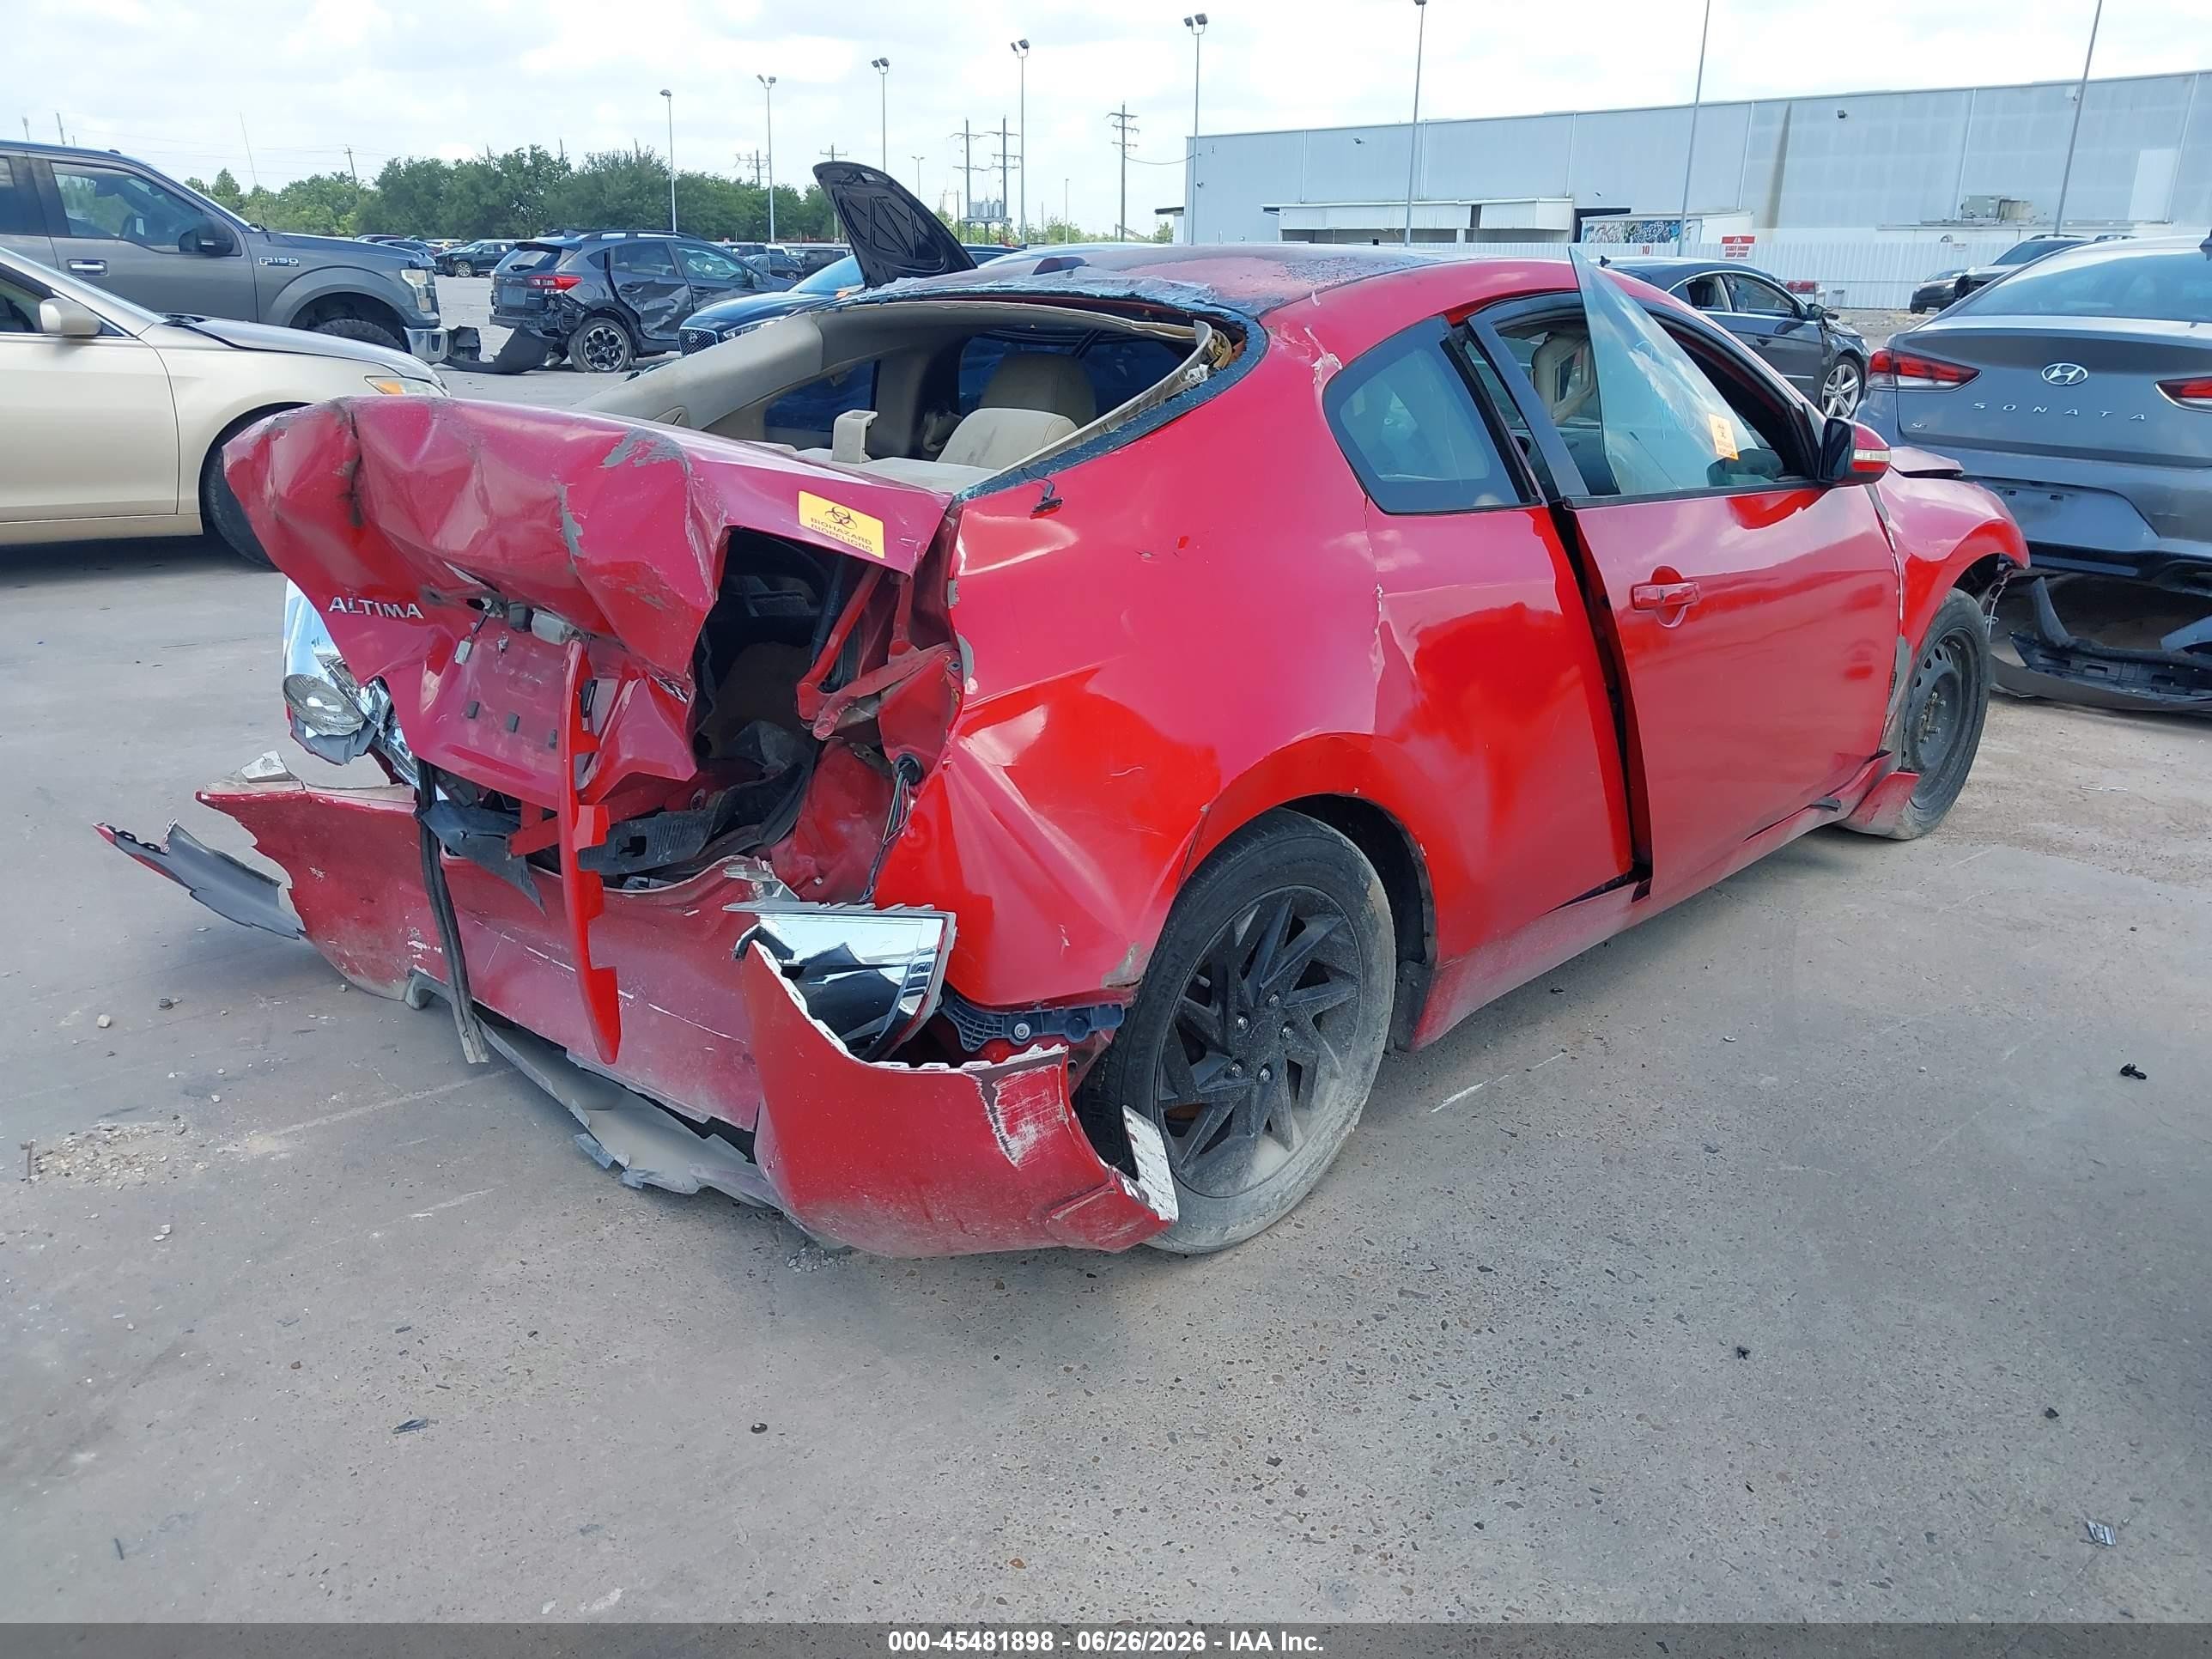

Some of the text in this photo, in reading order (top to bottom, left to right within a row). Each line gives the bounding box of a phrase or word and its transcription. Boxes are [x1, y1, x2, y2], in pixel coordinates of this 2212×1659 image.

[1973, 402, 2146, 422] SONATA
[810, 517, 872, 545] BIOHAZARD
[811, 524, 873, 552] BIOPELIGRO
[328, 597, 424, 619] ALTIMA
